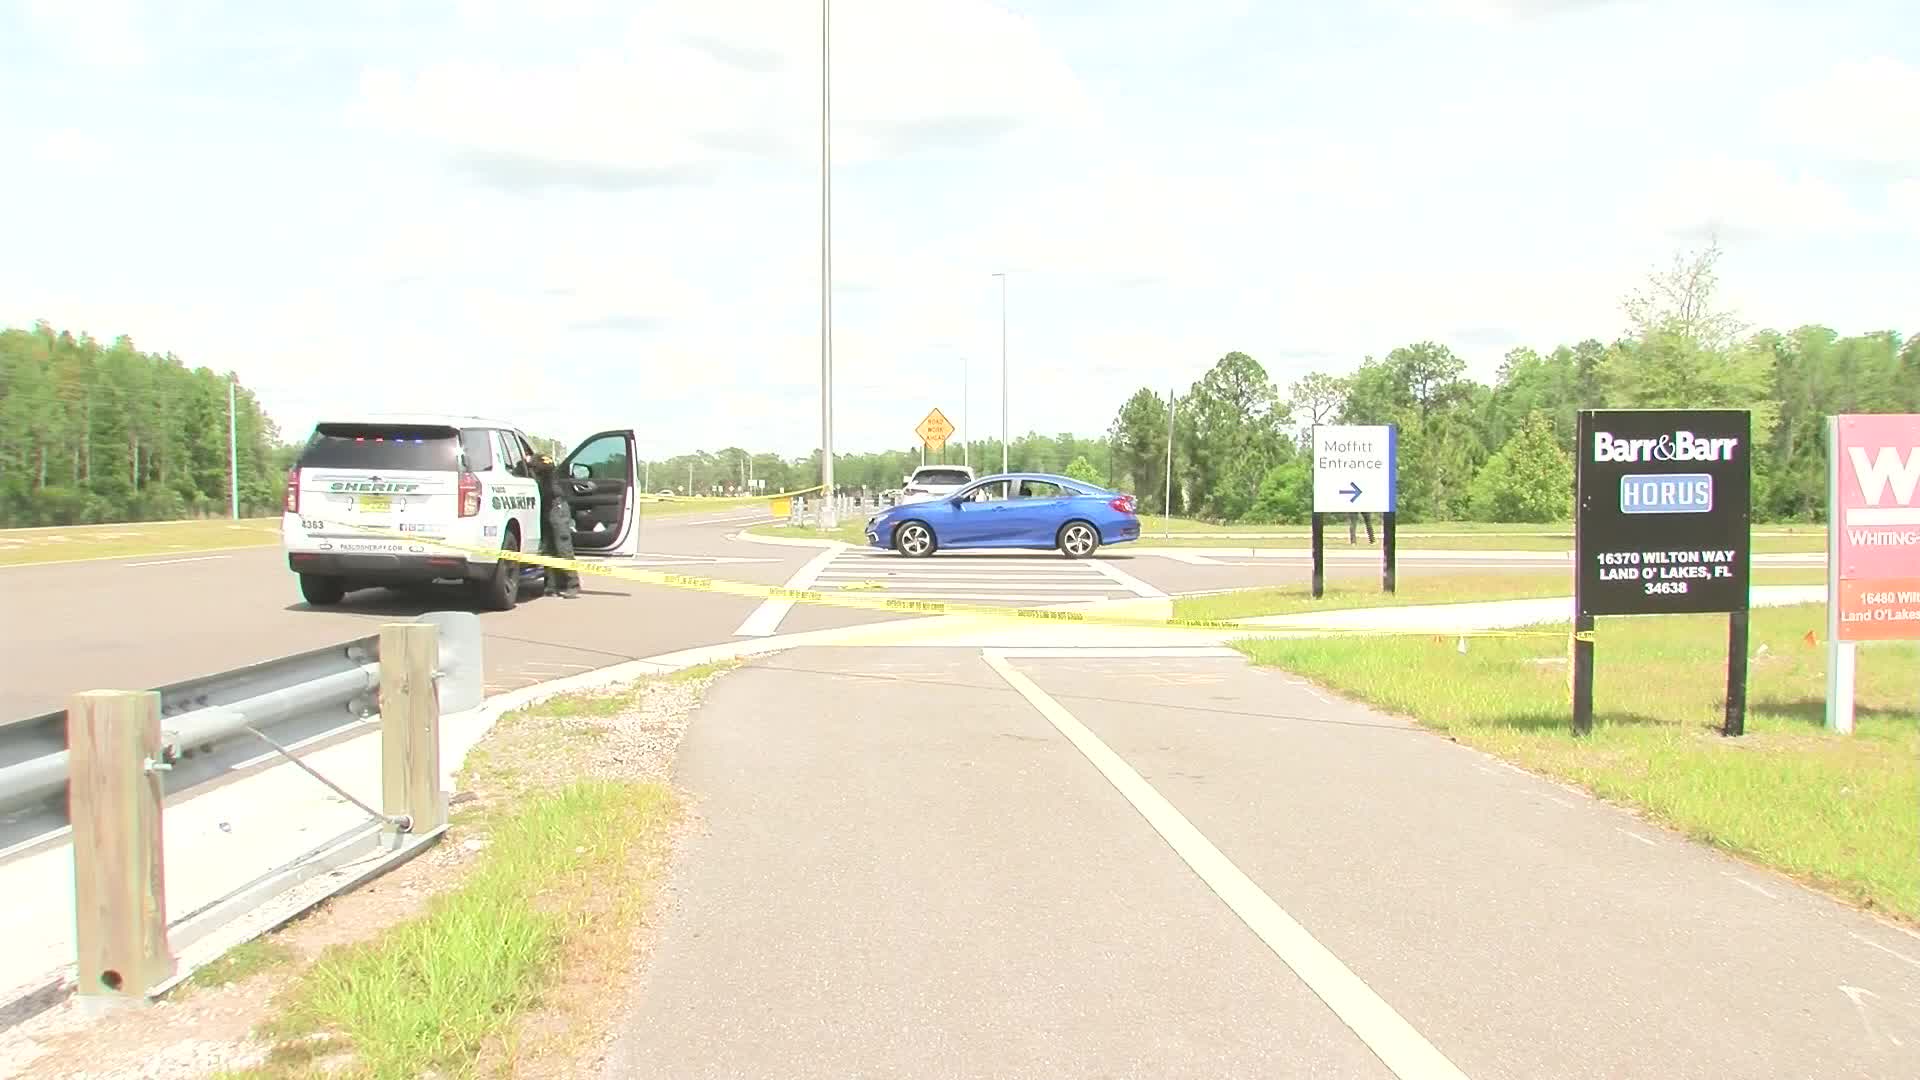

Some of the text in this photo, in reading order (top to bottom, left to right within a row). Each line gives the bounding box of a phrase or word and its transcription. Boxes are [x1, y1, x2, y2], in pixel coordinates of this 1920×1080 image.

[1324, 440, 1373, 453] Moffitt
[1594, 431, 1738, 462] Barr&Barr
[1319, 457, 1383, 469] Entrance
[330, 482, 419, 493] SHERIFF
[1624, 481, 1709, 506] HORUS
[491, 496, 536, 510] SHERIFF
[1597, 550, 1735, 565] 16370 WILTON WAY
[1599, 566, 1732, 580] LAND O' LAKES, FL
[1644, 582, 1688, 594] 34638
[1860, 592, 1895, 604] 16480
[1840, 609, 1872, 621] Land
